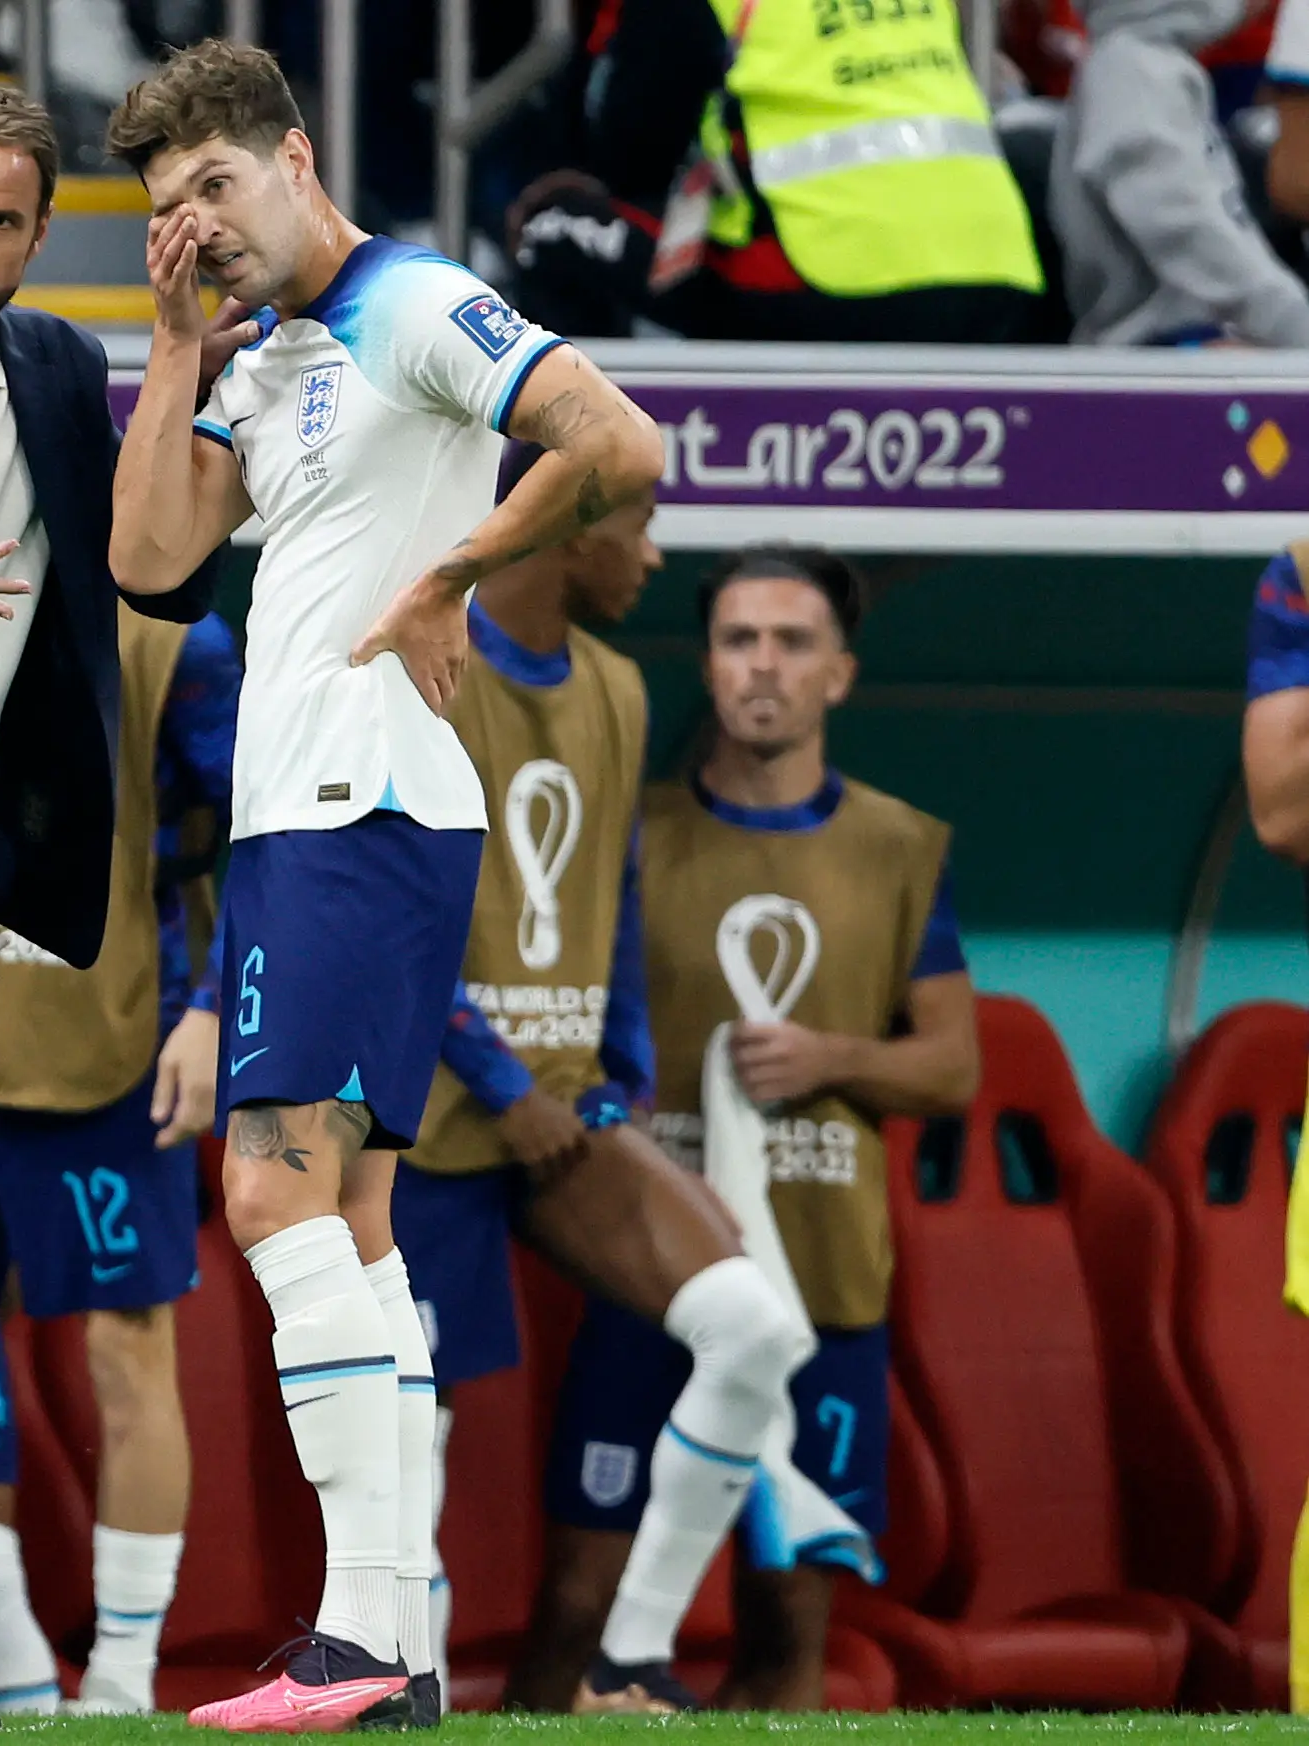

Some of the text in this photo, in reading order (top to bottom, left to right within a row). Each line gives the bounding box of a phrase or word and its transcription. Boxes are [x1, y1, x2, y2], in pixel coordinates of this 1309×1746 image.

[237, 945, 264, 1036] 5
[62, 1166, 139, 1254] 12
[817, 1394, 857, 1477] 7
